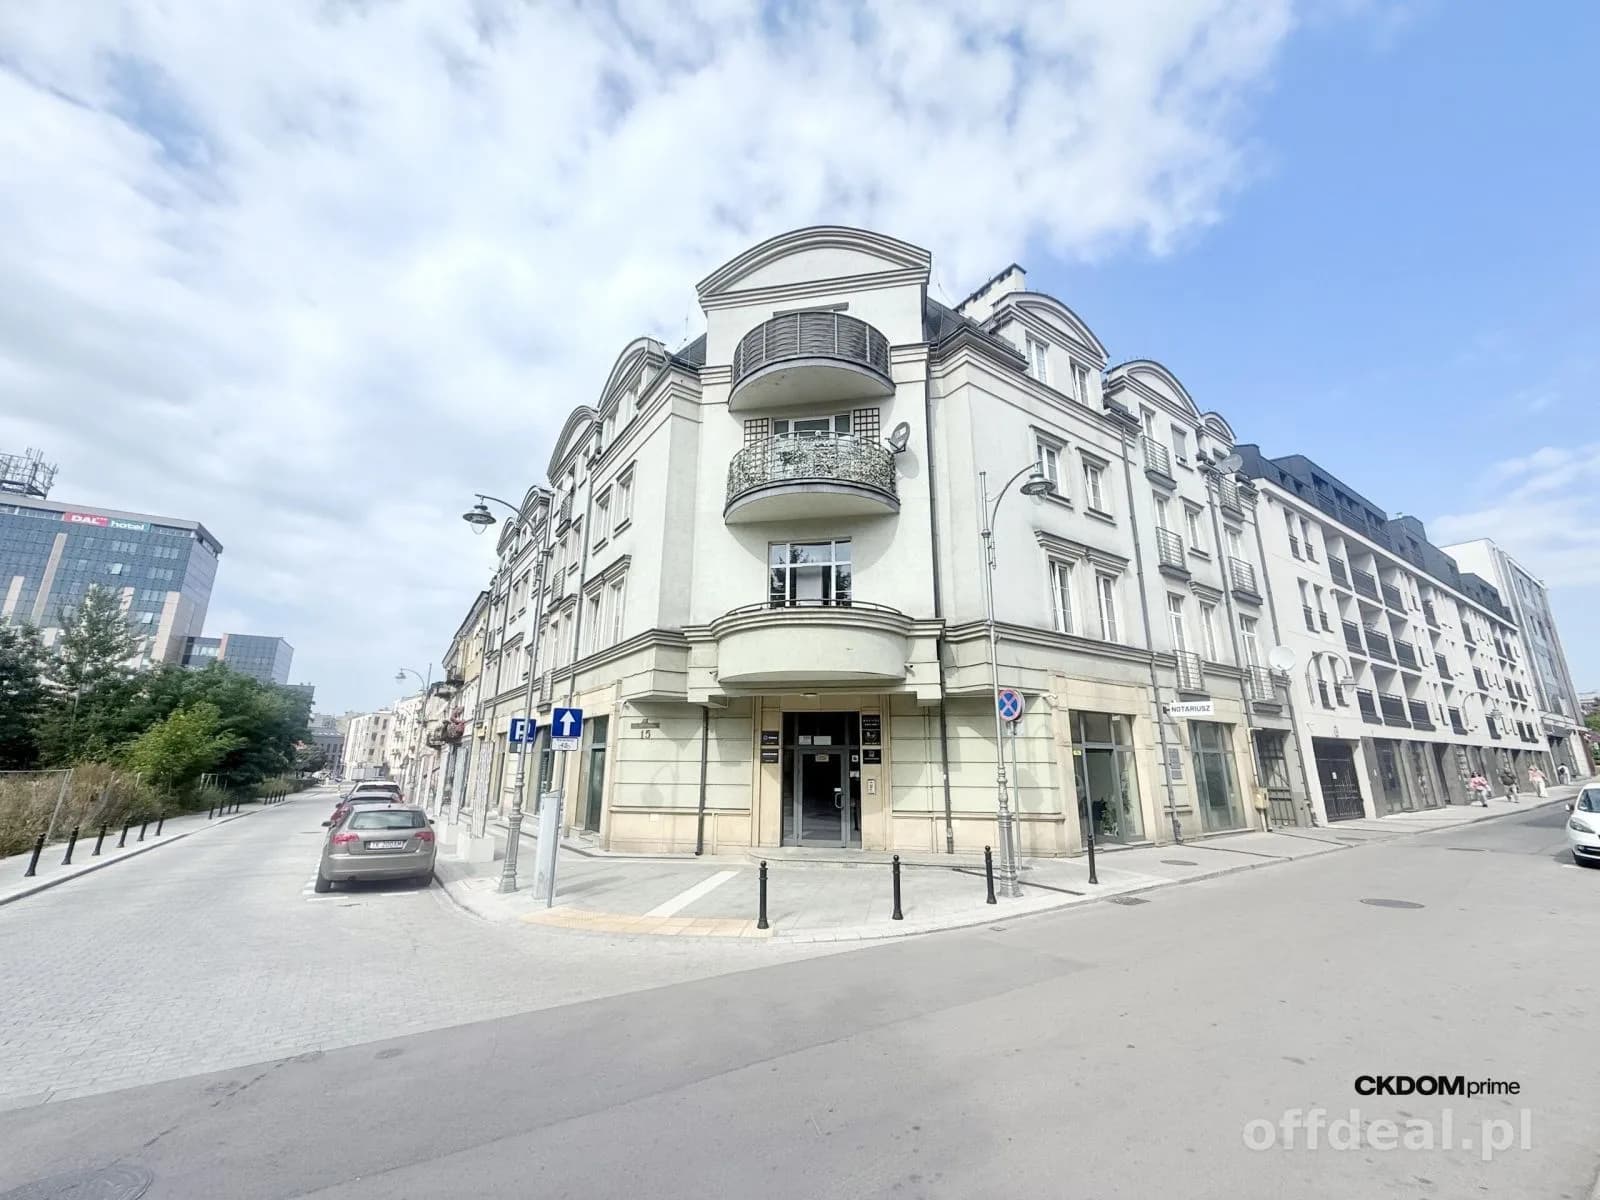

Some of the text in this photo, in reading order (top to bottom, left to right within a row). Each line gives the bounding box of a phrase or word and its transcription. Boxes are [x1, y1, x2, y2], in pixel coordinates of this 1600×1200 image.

[71, 514, 145, 531] DAL hotel
[1171, 704, 1211, 713] NOTARIUSZ
[515, 721, 531, 740] P
[640, 729, 651, 740] 15
